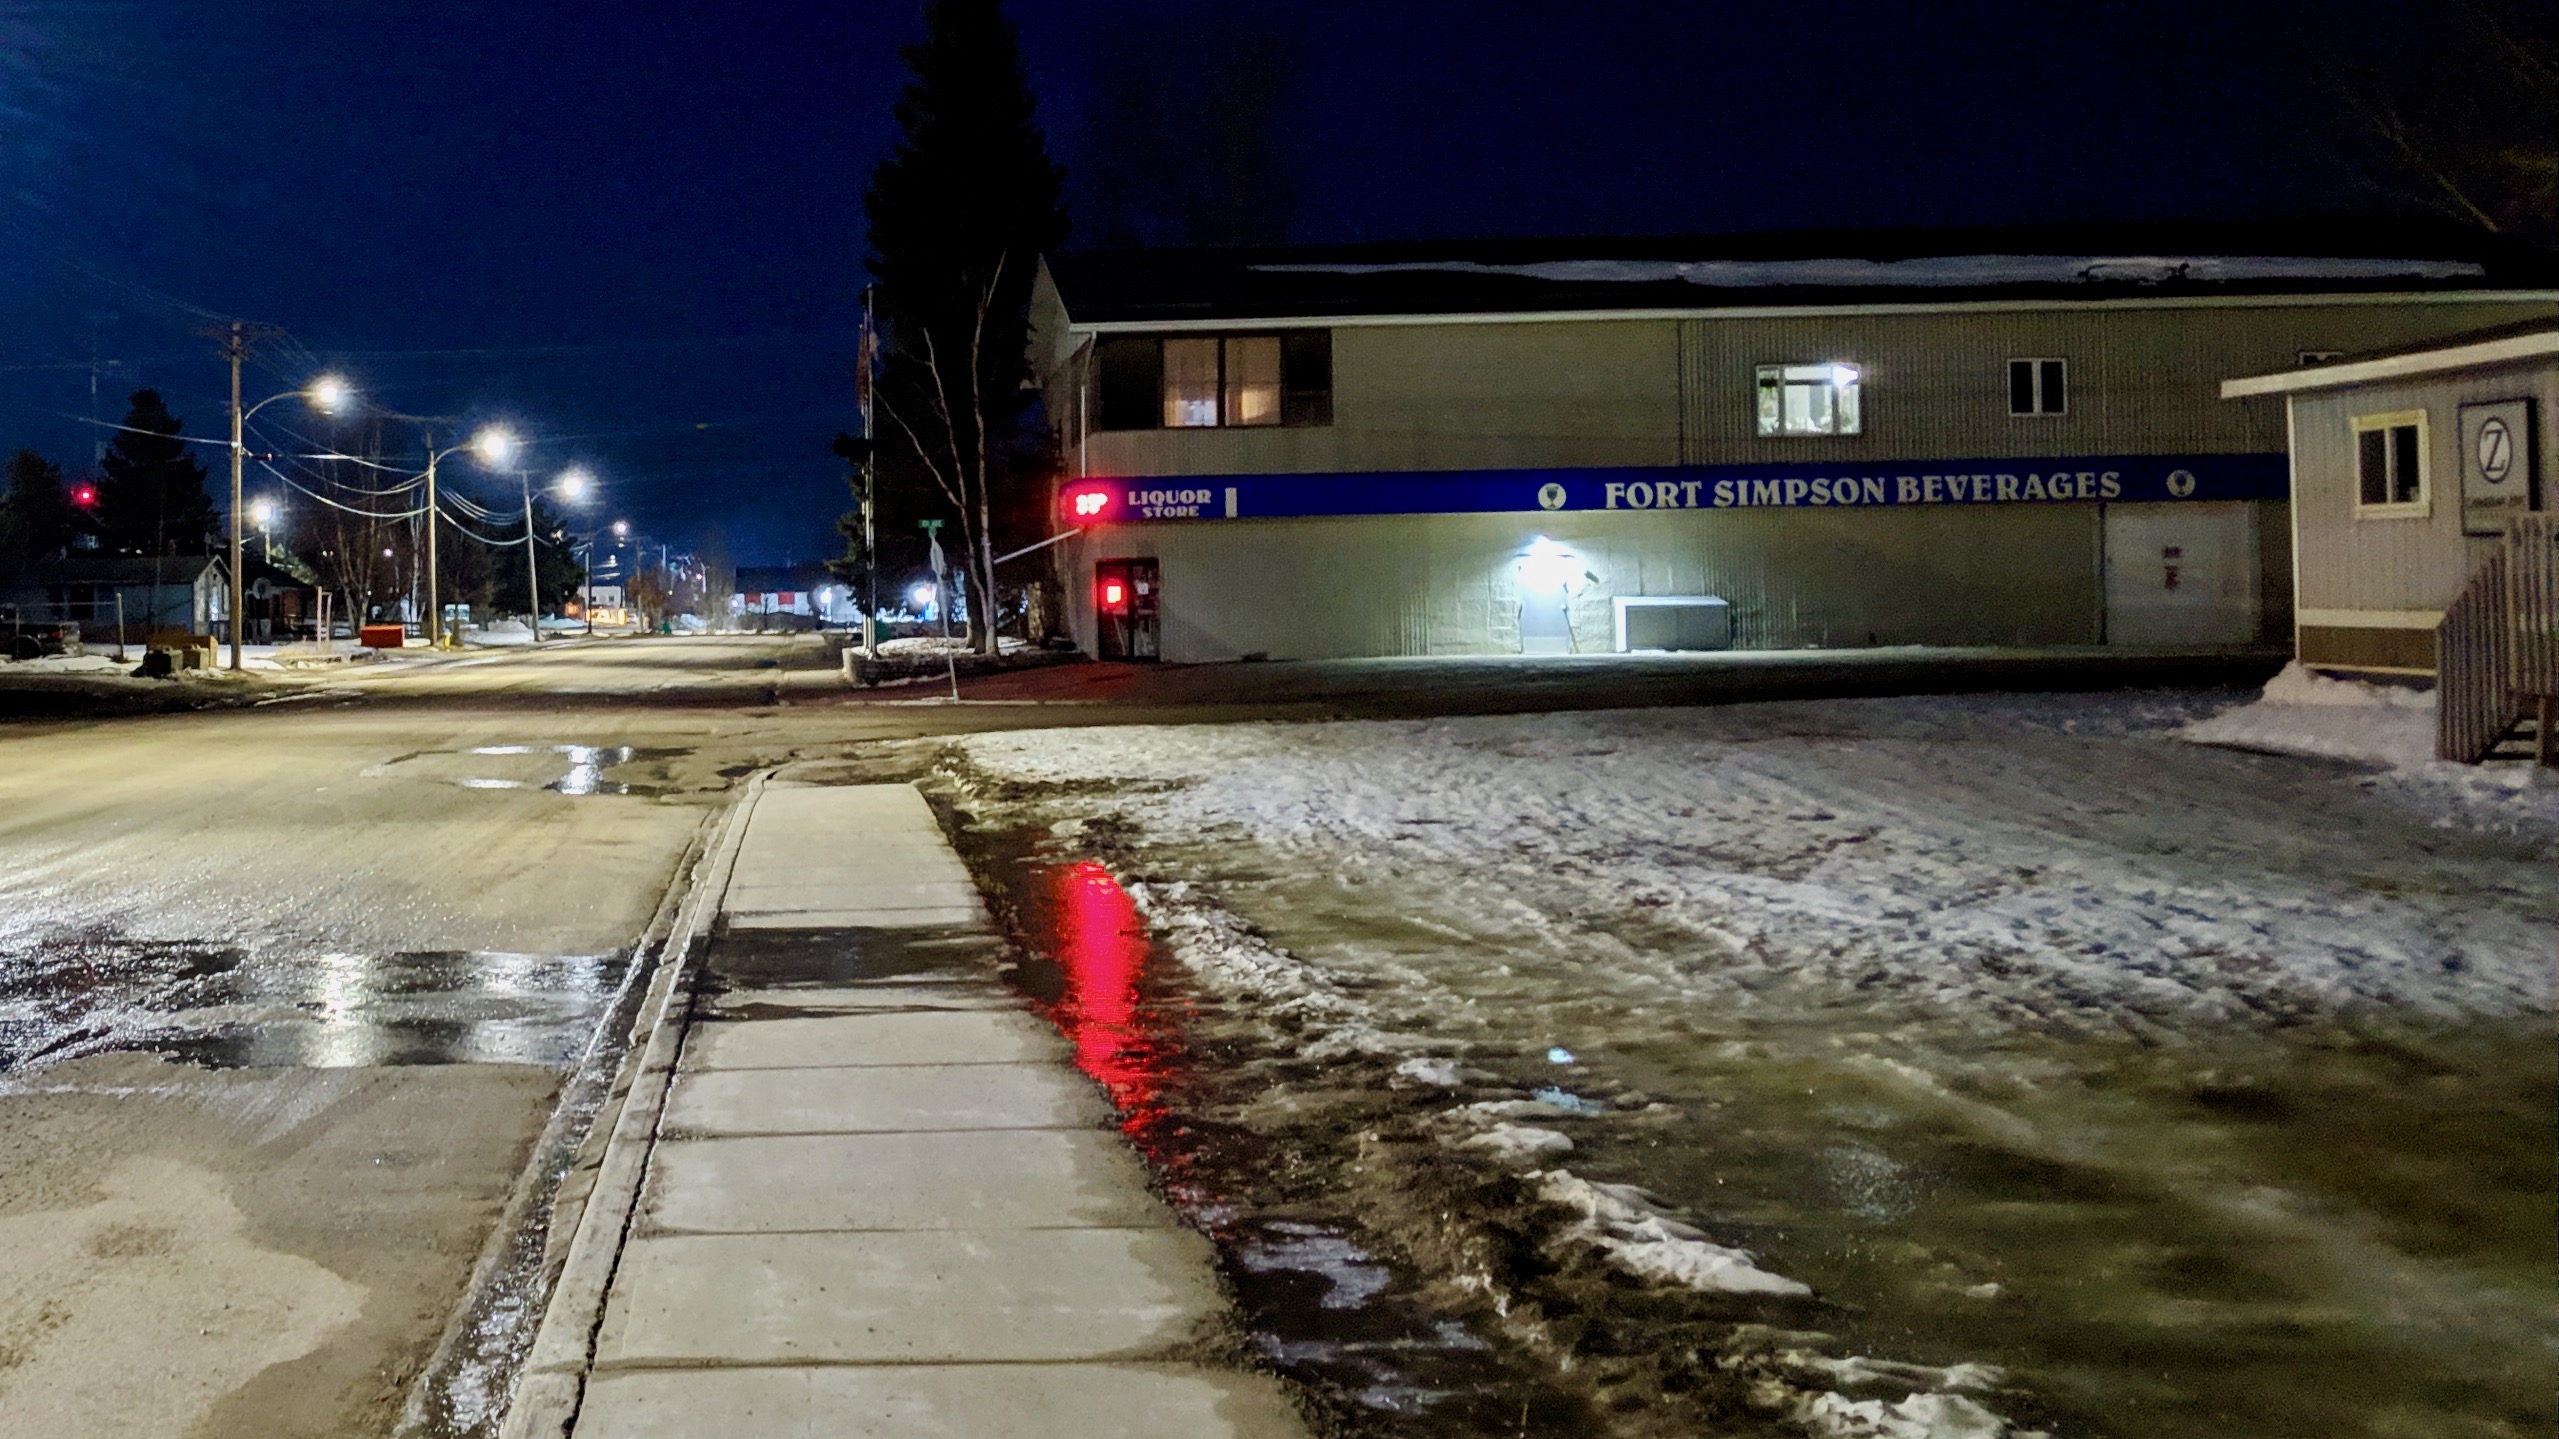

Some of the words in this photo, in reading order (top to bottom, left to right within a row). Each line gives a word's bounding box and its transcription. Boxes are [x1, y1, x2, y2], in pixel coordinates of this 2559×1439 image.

[1128, 488, 1211, 506] LIQUOR
[1605, 481, 1702, 509] FORT
[1713, 476, 1886, 507] SIMPSON
[1896, 472, 2121, 503] BEVERAGES
[1142, 506, 1200, 518] STORE
